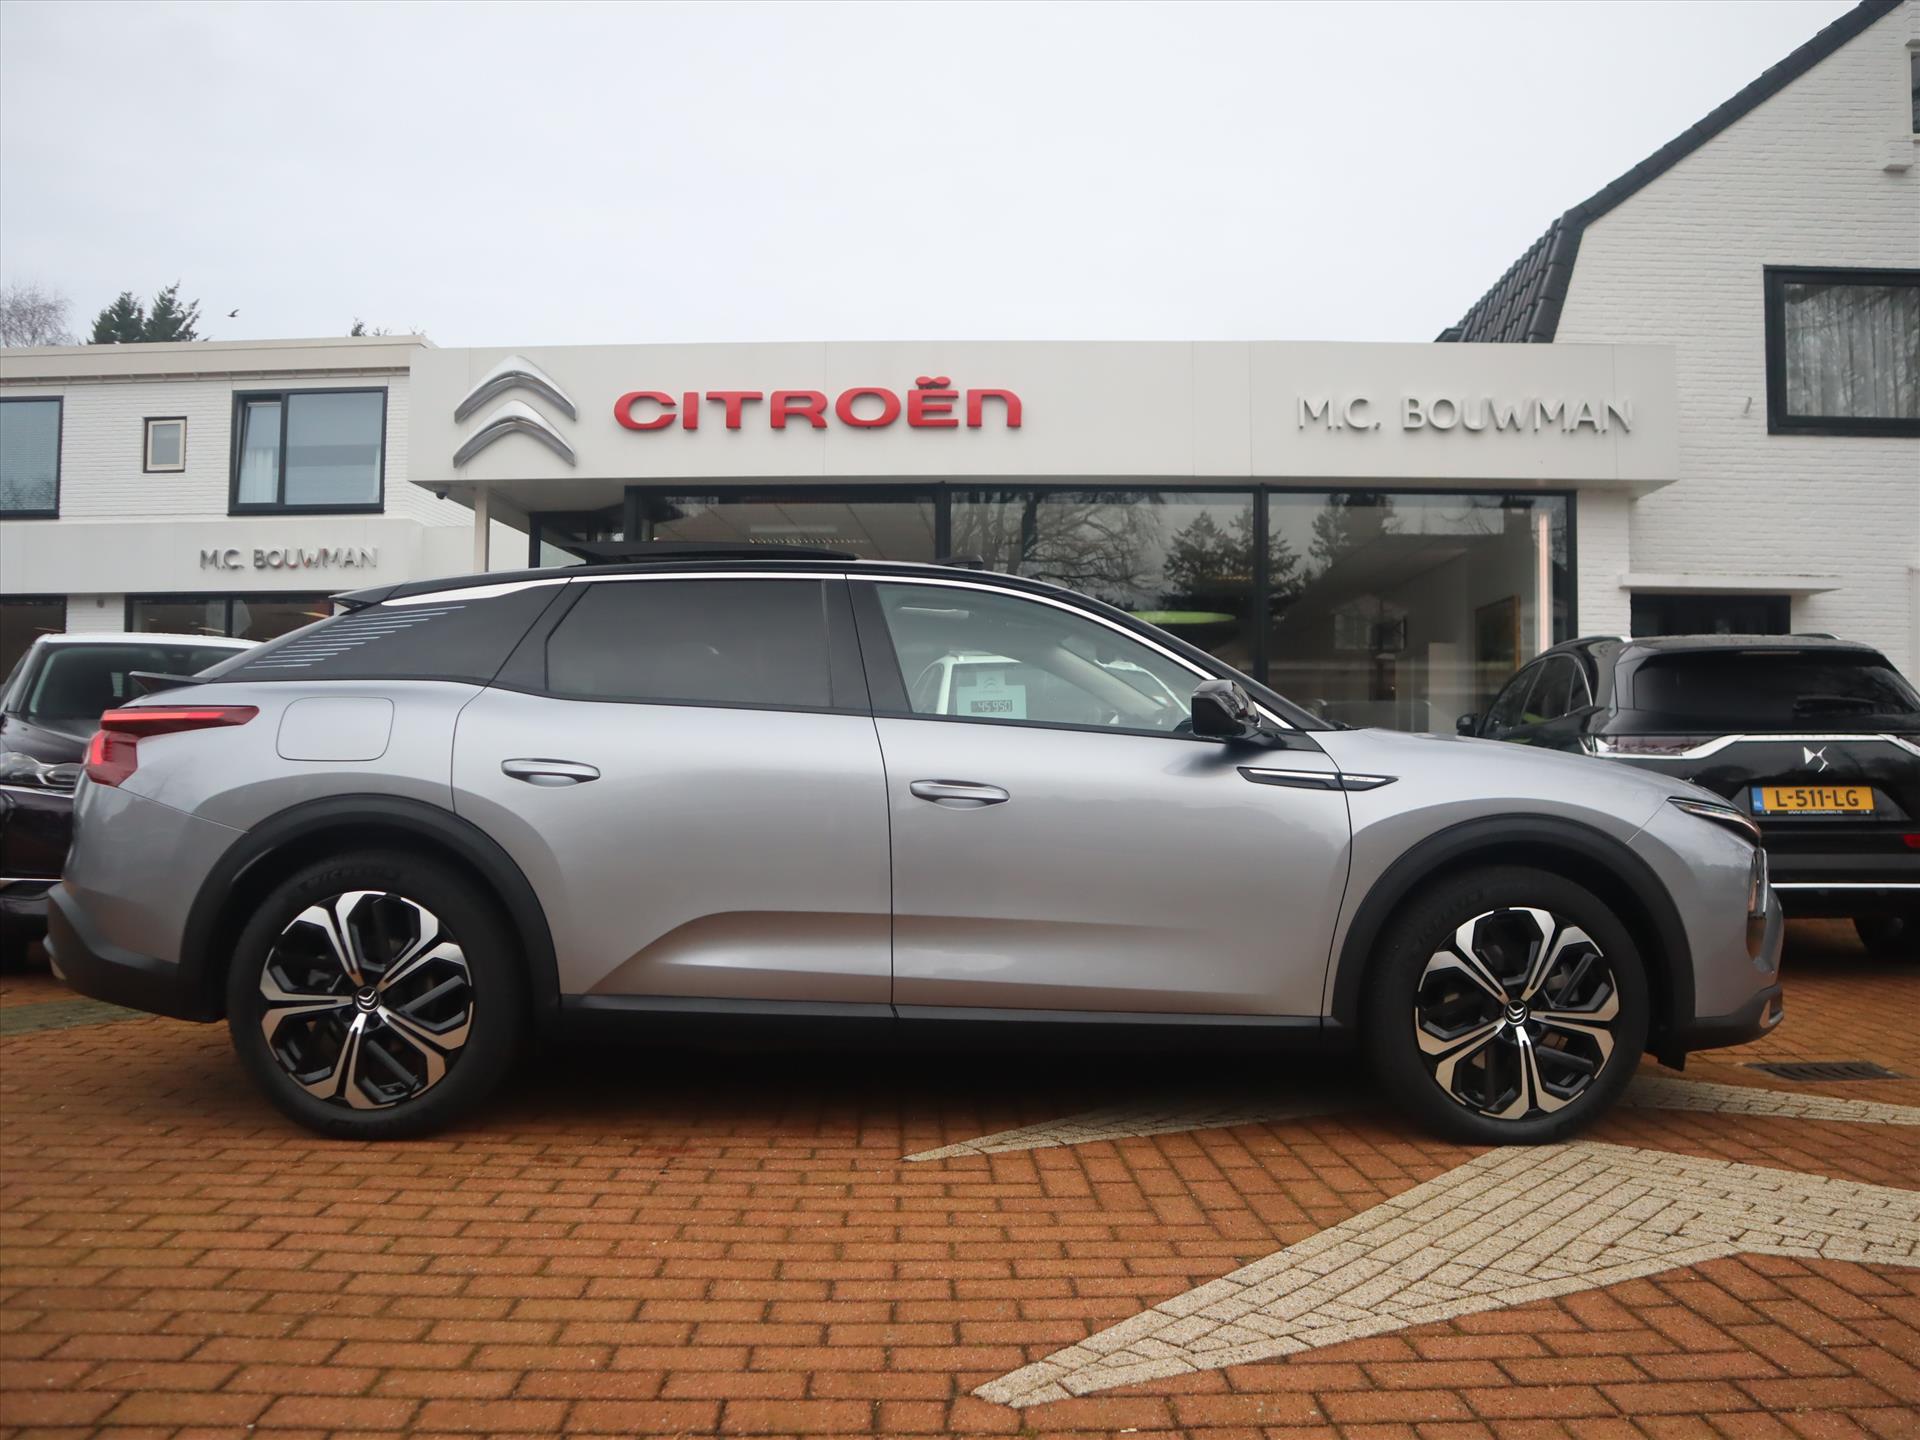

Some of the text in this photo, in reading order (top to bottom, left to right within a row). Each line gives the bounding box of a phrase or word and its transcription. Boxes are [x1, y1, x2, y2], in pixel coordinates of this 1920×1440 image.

[1298, 398, 1633, 433] M.C. BOUWMAN
[199, 547, 377, 569] M.C. BOUWMAN
[1775, 789, 1859, 807] L-511-LG
